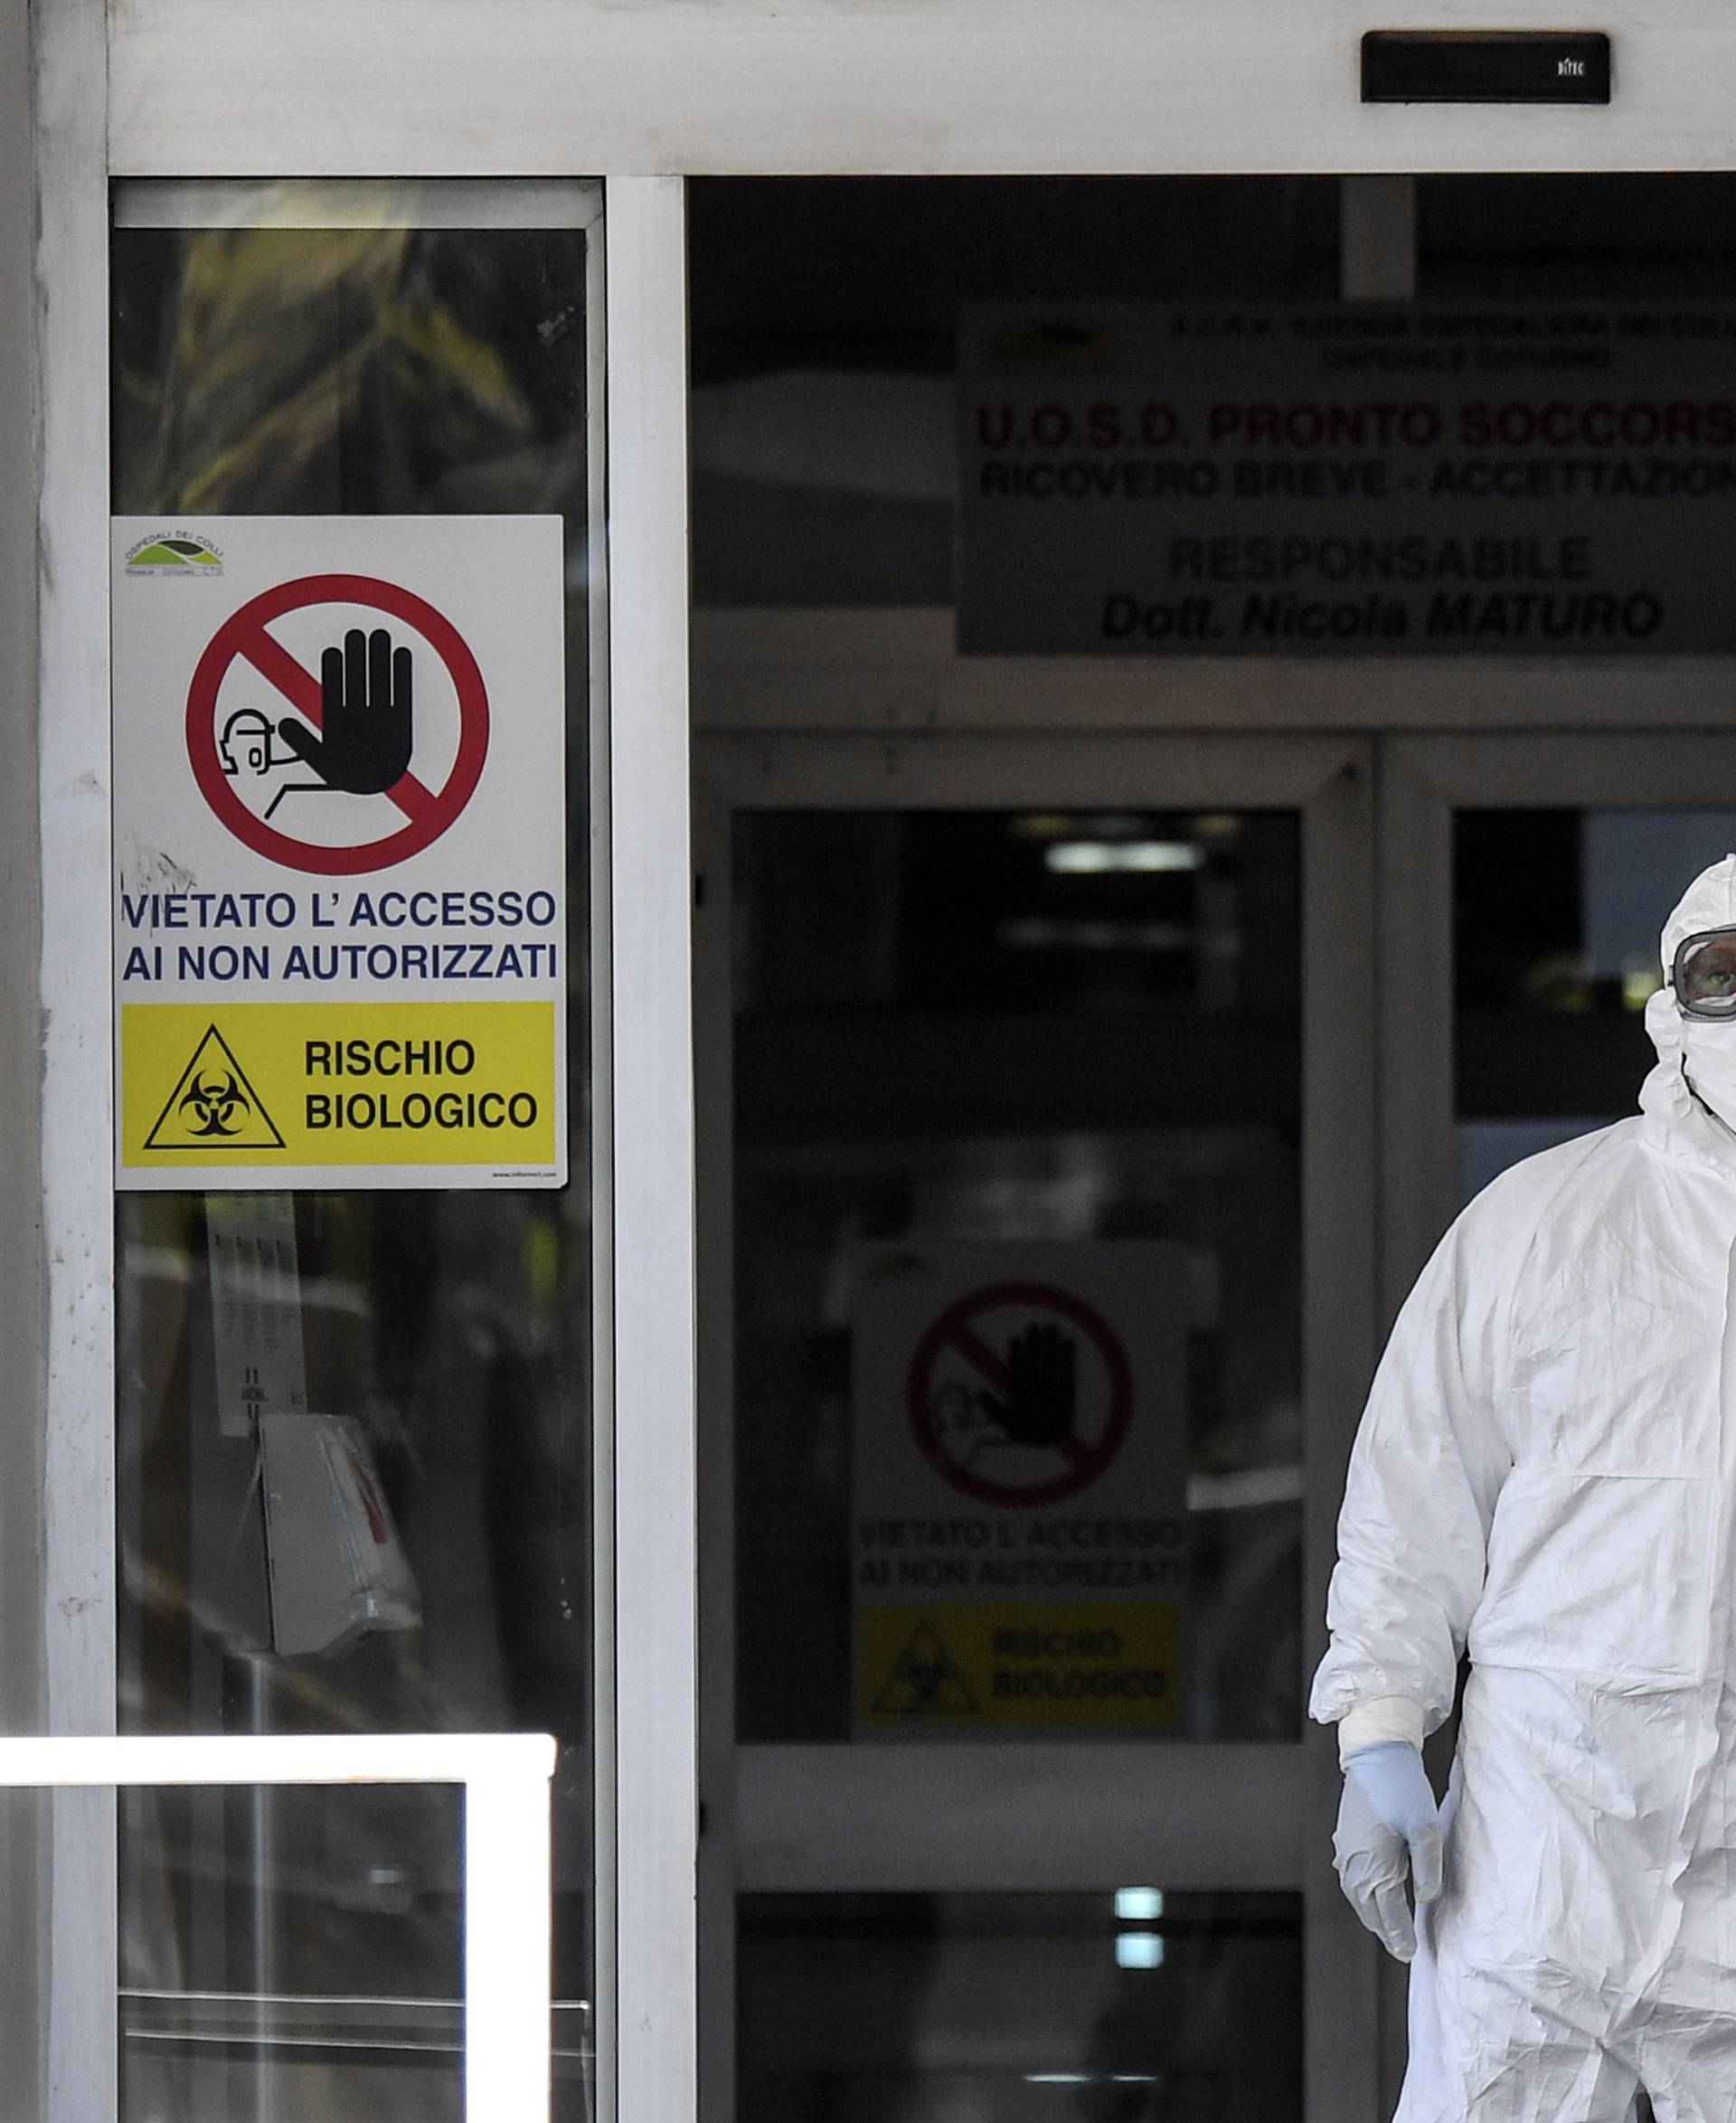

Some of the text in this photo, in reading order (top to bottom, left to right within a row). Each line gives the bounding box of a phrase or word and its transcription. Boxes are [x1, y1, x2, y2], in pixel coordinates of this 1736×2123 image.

[976, 403, 1187, 448] U.O.S.D.
[1210, 403, 1441, 448] PRONTO
[981, 461, 1218, 498] RICOVERO
[1233, 461, 1385, 498] BREVE
[1169, 538, 1593, 581] RESPONSABILE
[1102, 593, 1663, 638] Dott. Nicola MATURO
[122, 893, 296, 928] VIETATO
[349, 891, 556, 927] ACCESSO
[122, 944, 556, 980] AI NON AUTORIZZATI
[305, 1040, 476, 1076] RISCHIO
[305, 1092, 538, 1129] BIOLOGICO
